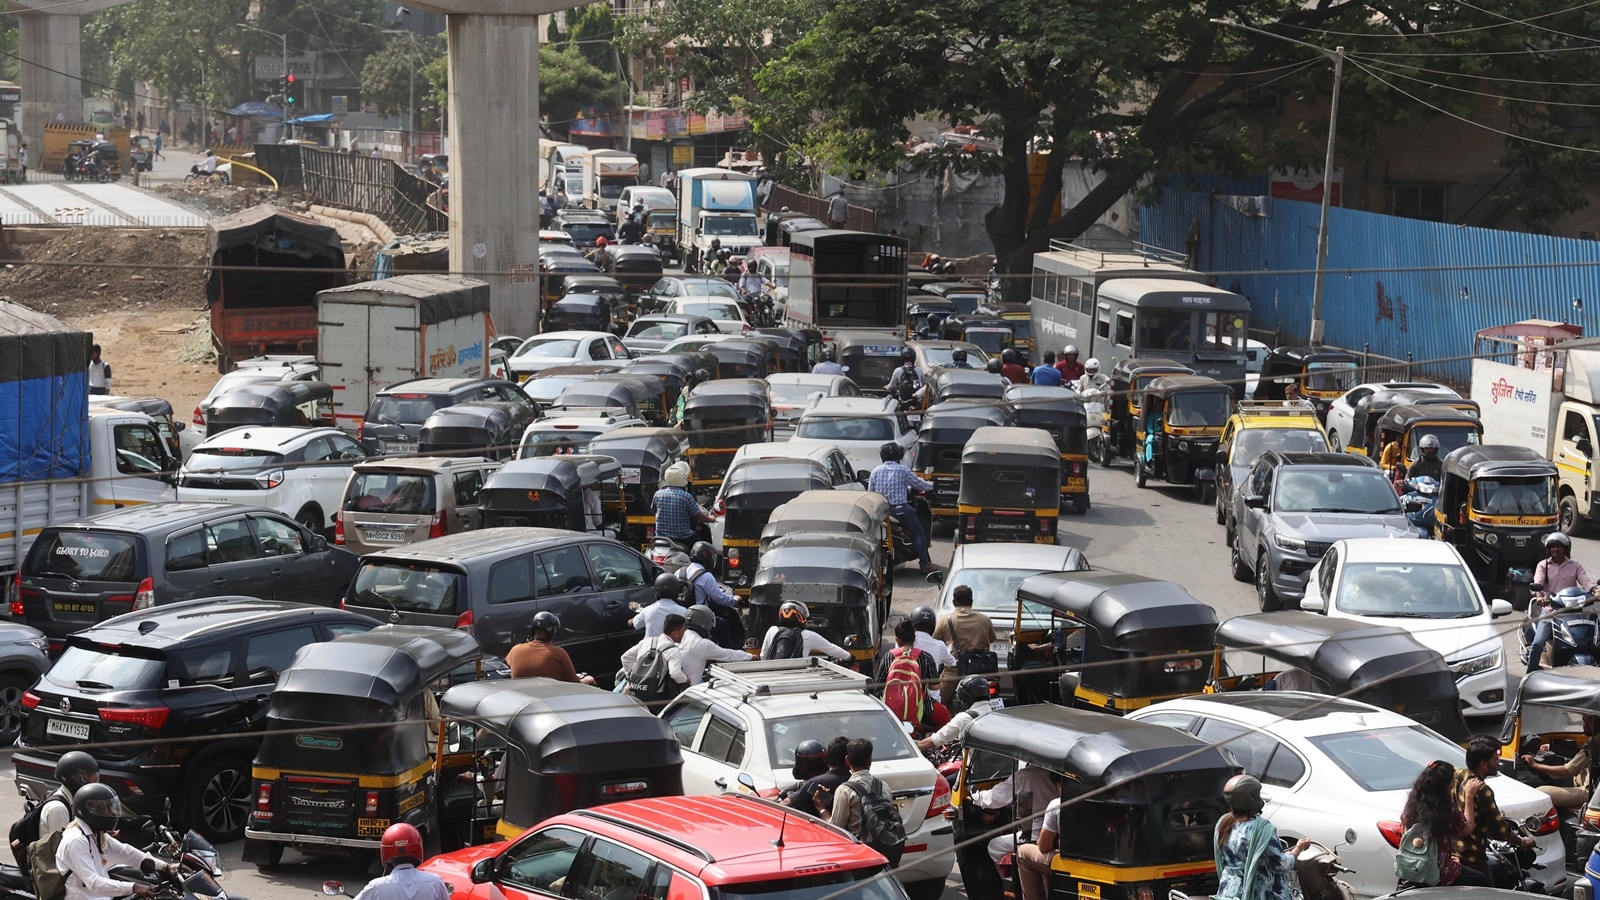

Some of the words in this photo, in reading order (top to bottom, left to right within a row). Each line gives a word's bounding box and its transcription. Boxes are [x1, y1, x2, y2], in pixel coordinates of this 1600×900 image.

[255, 62, 285, 73] HOTEL
[1491, 378, 1514, 404] सुजित
[56, 546, 79, 556] GLORY
[80, 548, 88, 556] TO
[90, 548, 110, 558] LORD
[630, 682, 649, 691] NIKE
[51, 722, 89, 736] MH47AY1532
